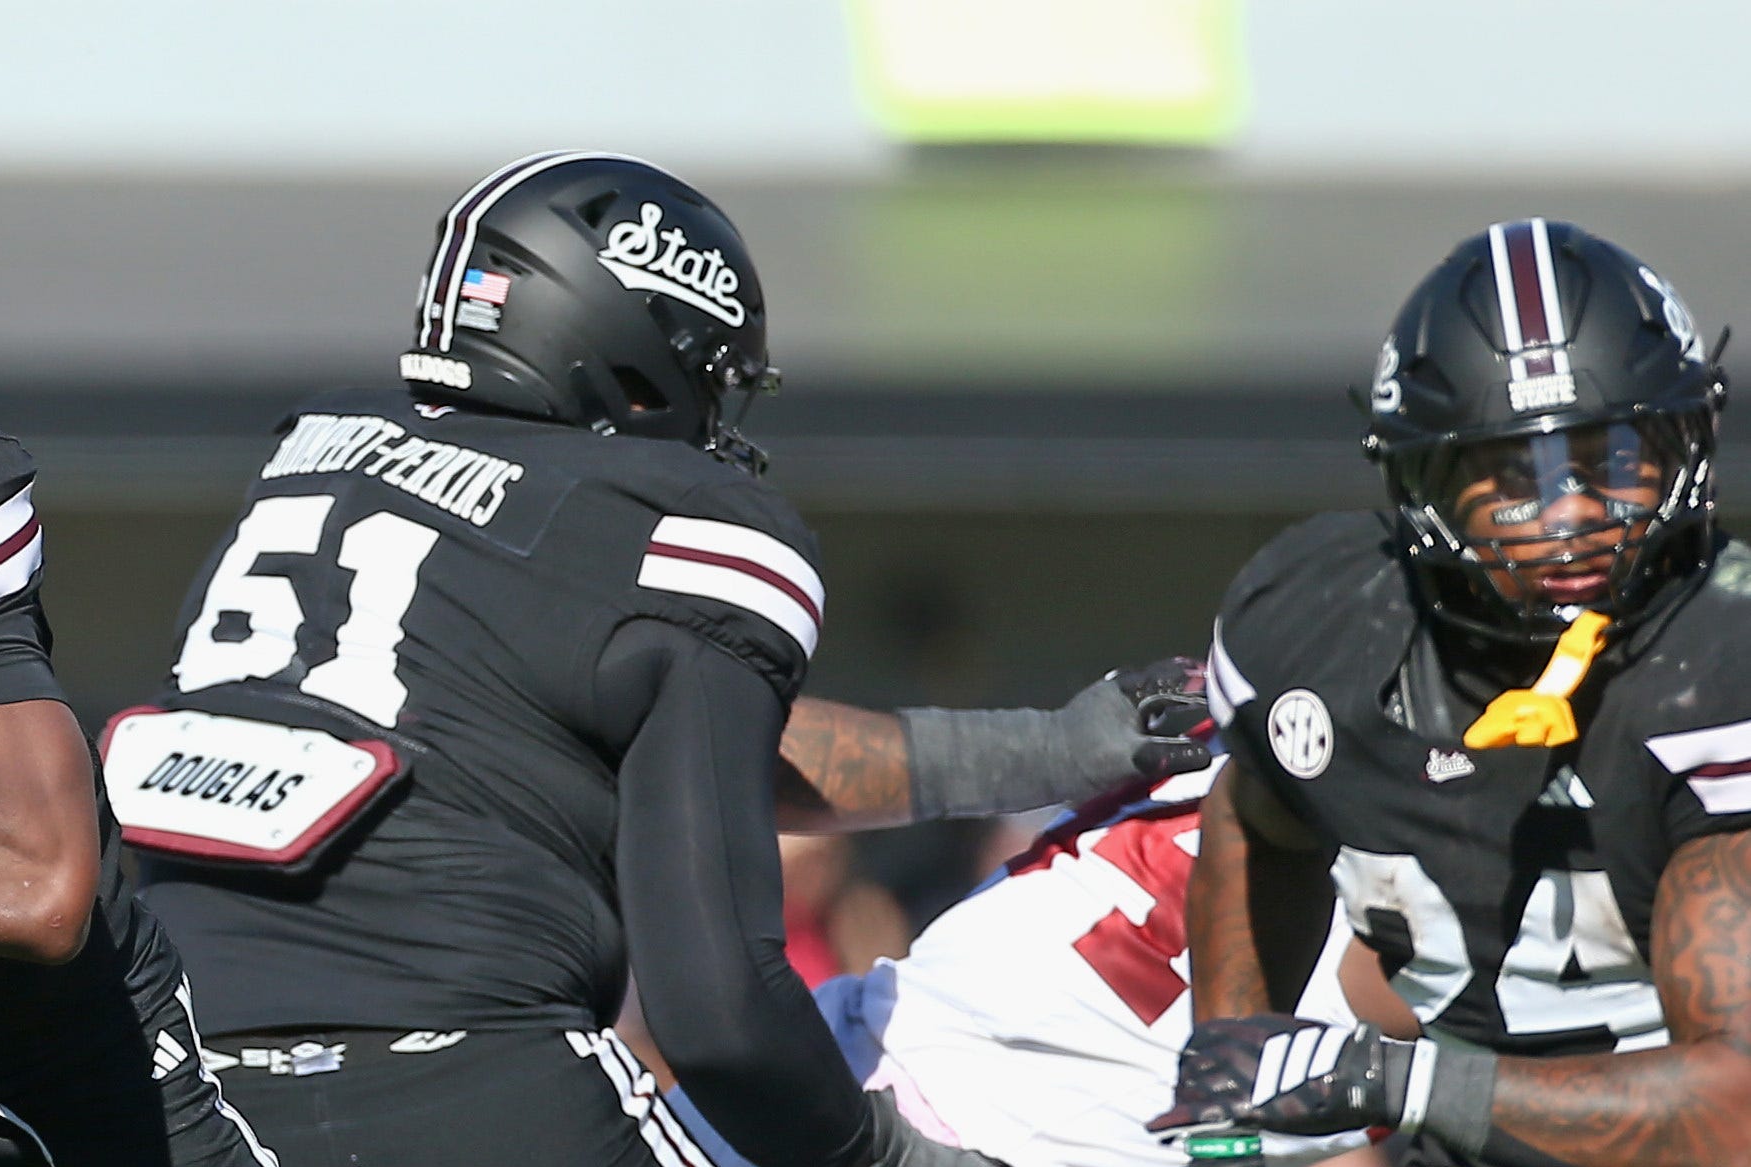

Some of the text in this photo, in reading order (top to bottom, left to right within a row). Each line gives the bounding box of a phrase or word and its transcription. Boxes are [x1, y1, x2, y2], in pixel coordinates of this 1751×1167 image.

[597, 202, 745, 328] State
[400, 353, 472, 389] LLDOGS
[171, 493, 440, 730] 61
[138, 751, 306, 813] DOUGLAS
[1425, 748, 1476, 783] State
